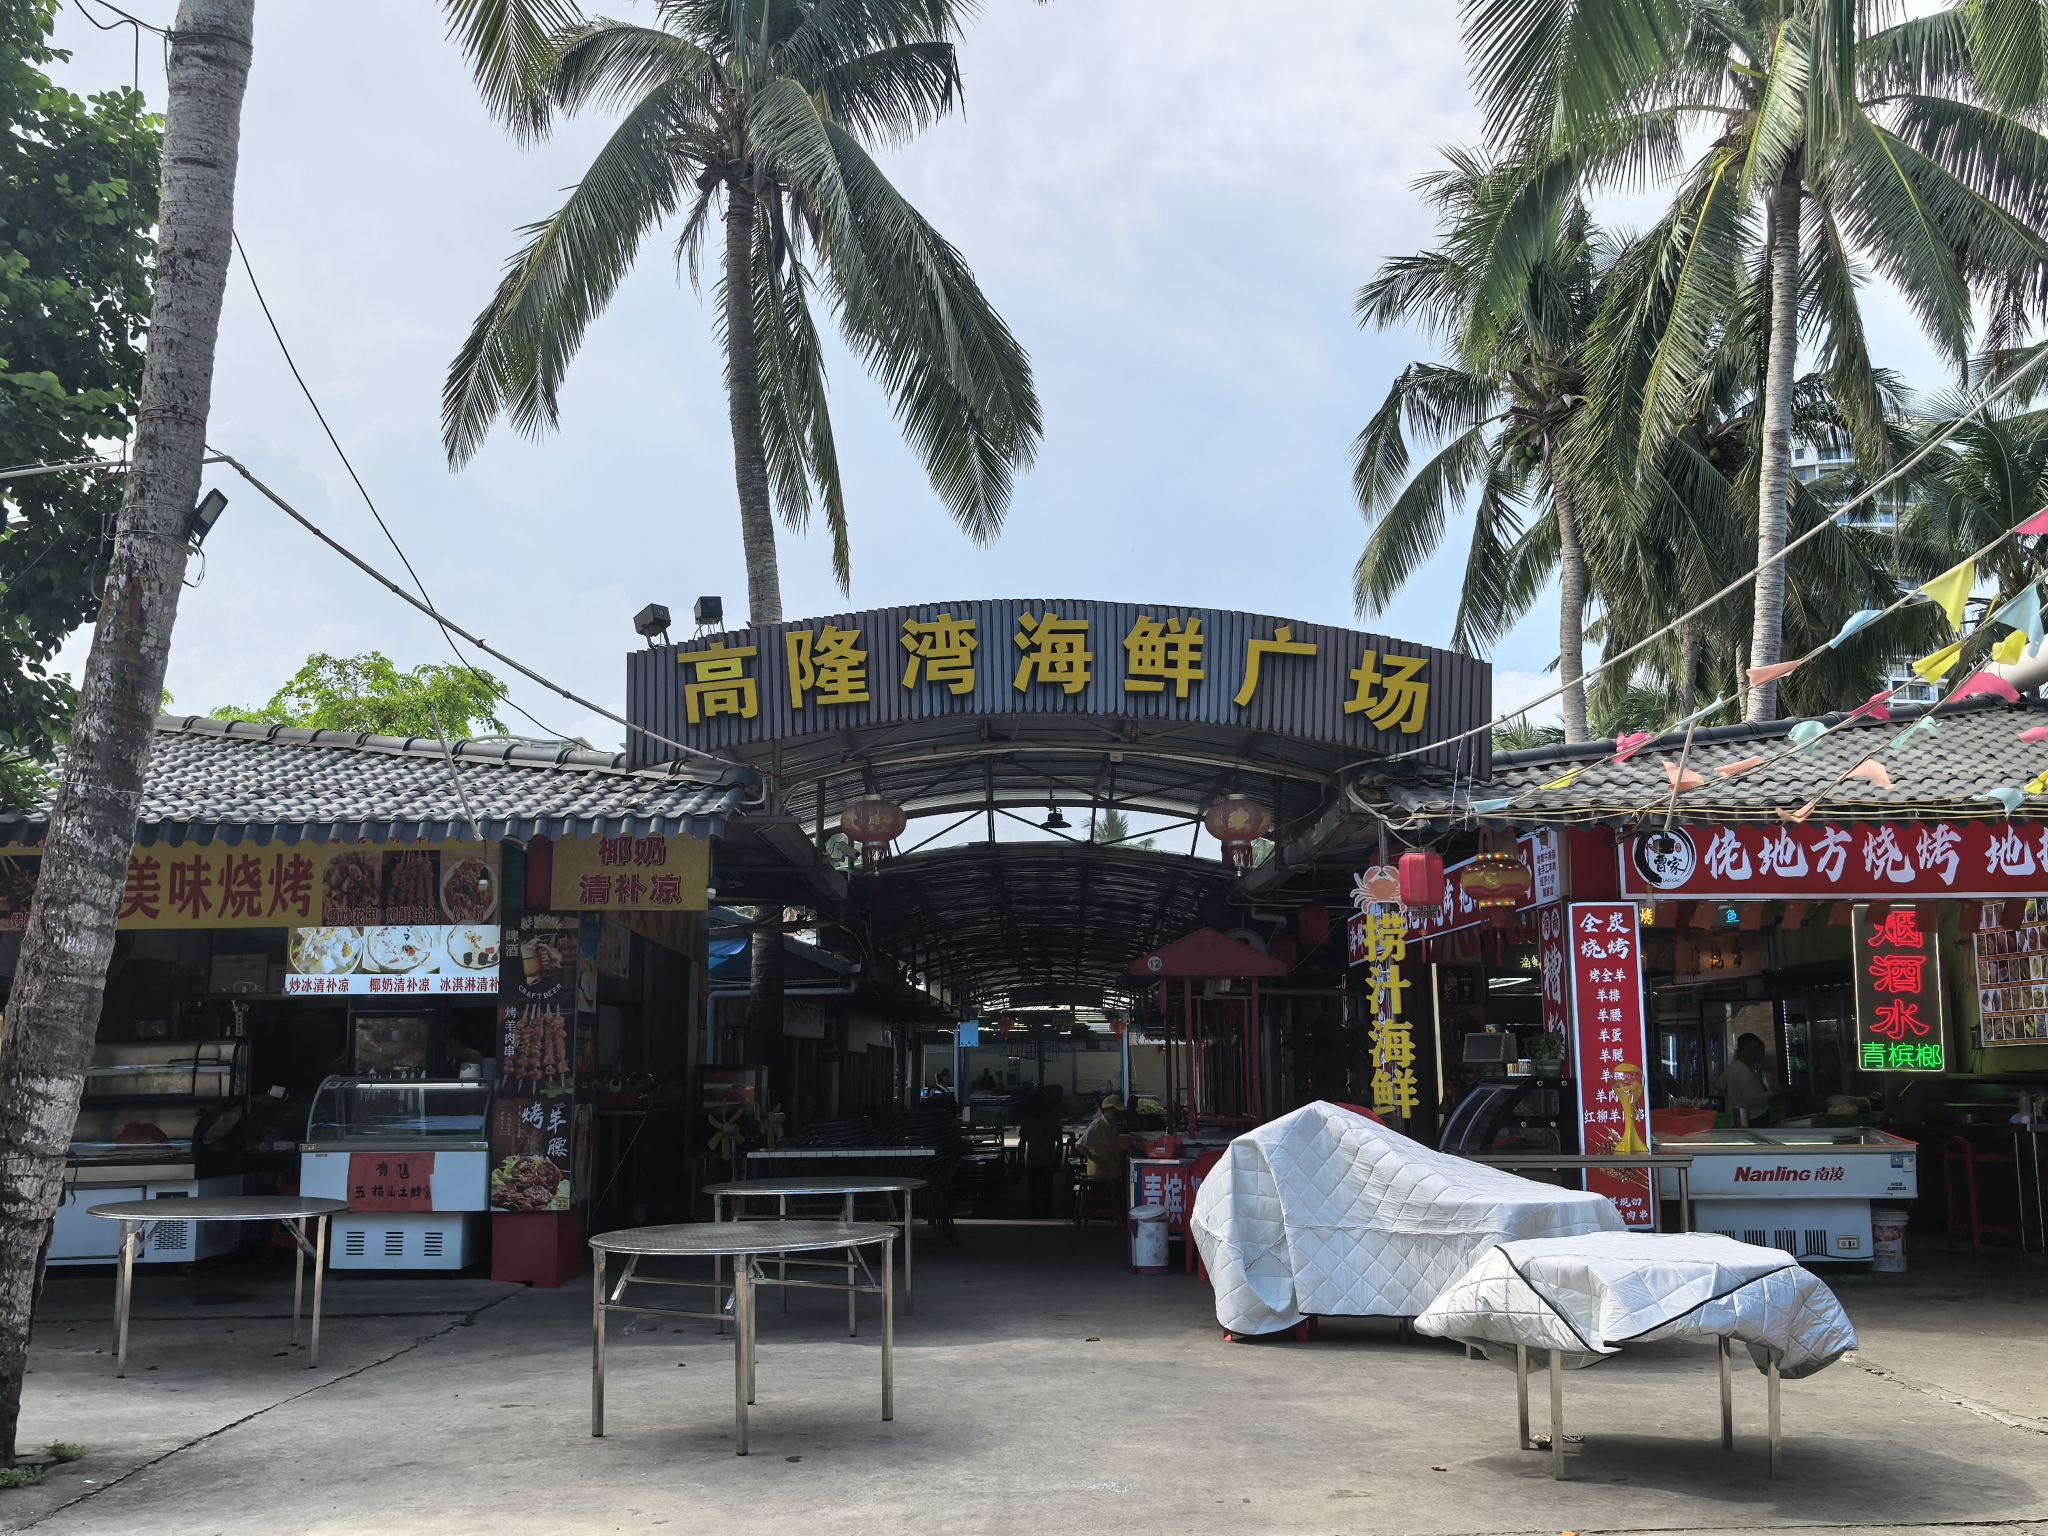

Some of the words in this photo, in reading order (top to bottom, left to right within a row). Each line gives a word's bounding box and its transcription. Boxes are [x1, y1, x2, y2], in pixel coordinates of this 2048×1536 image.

[677, 610, 1430, 734] 高隆湾海鲜广场
[599, 836, 666, 866] 椰奶
[1704, 823, 1961, 886] 佬地方烧烤
[118, 853, 314, 920] 美味烧烤
[579, 873, 683, 904] 清补凉
[505, 930, 519, 957] 啤酒
[289, 976, 349, 993] 炒冰清补凉
[369, 976, 430, 993] 椰奶清补凉
[1589, 967, 1626, 983] 烤全羊
[1868, 910, 1931, 1040] 烟酒水
[518, 985, 542, 999] CRAFT
[543, 982, 563, 999] BEER
[1596, 988, 1621, 1002] 羊排
[1362, 912, 1421, 1119] 捞汁海鲜
[1597, 1008, 1623, 1022] 羊腰
[504, 1006, 517, 1067] 烤羊肉串
[1598, 1027, 1622, 1043] 羊蛋
[1600, 1048, 1625, 1062] 羊腿
[1861, 1041, 1943, 1068] 青槟榔
[1814, 1166, 1845, 1181] 南凌
[1144, 1173, 1203, 1224] 青槟
